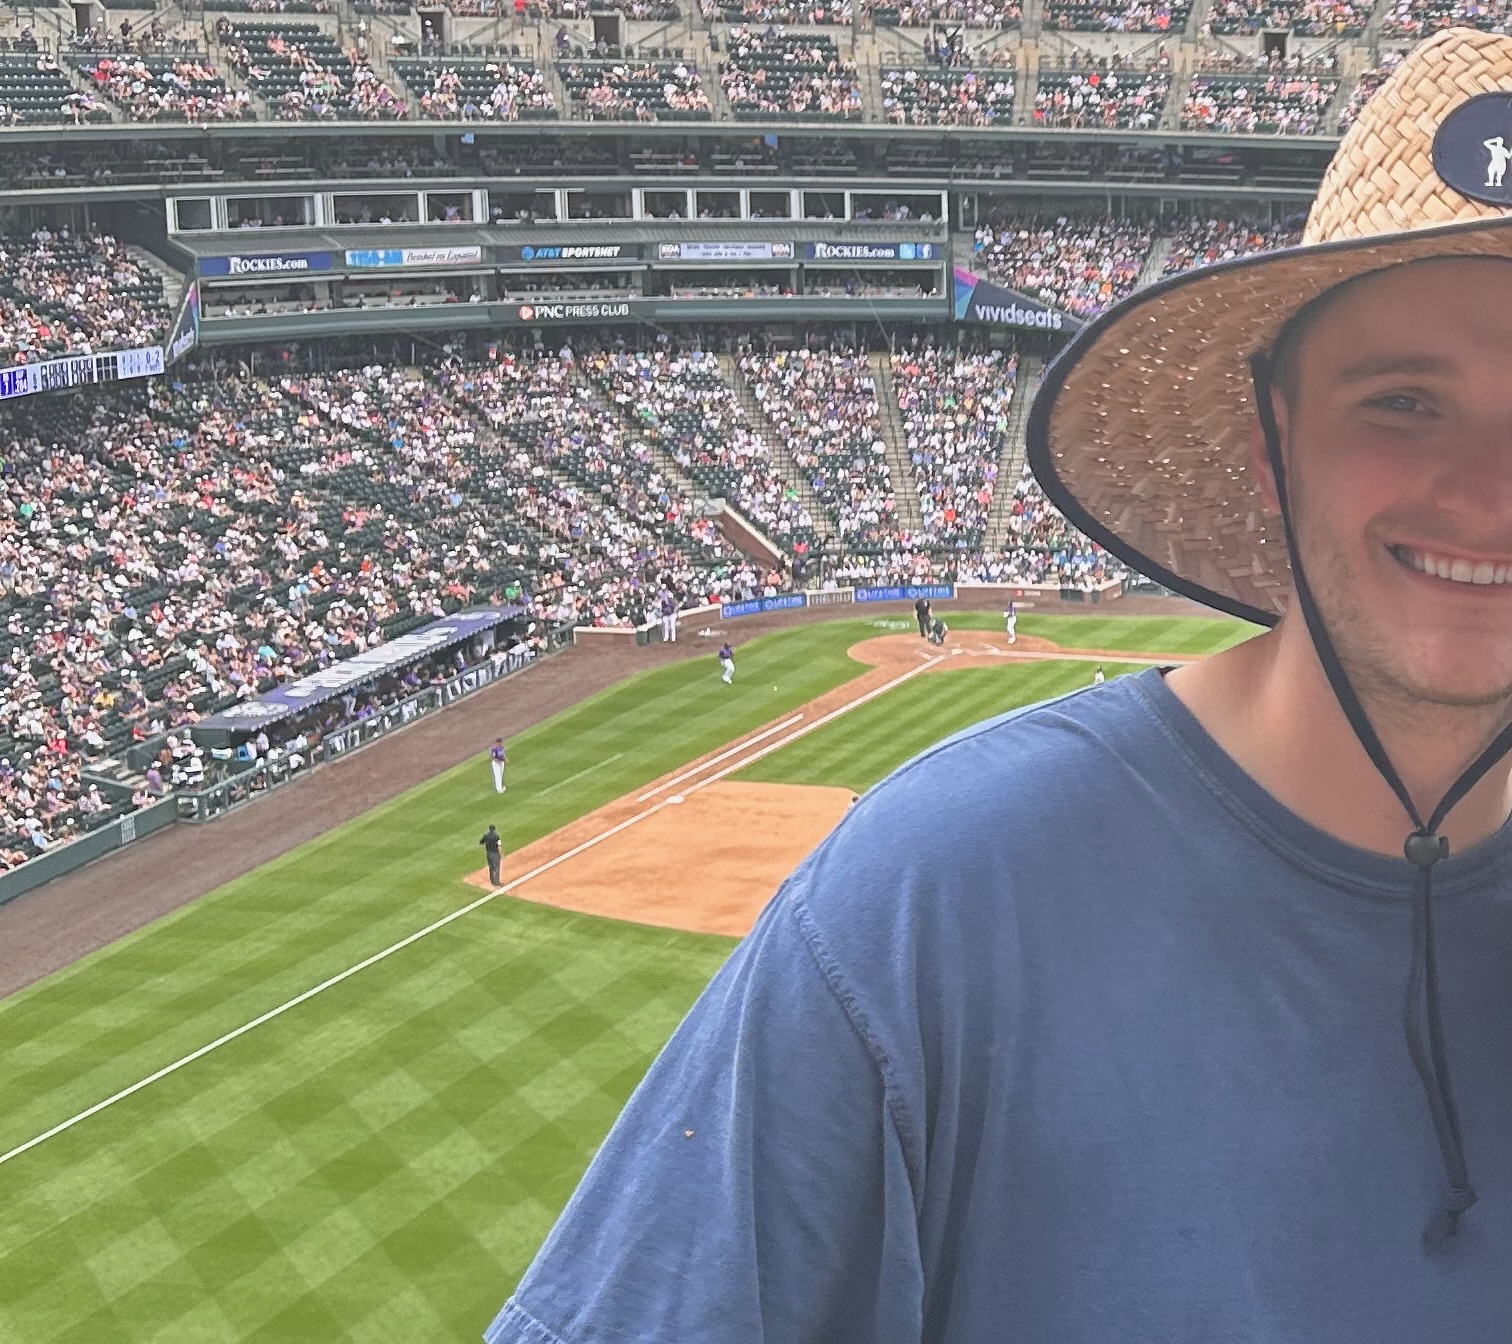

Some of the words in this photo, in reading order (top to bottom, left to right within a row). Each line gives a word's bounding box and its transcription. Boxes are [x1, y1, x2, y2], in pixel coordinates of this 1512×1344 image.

[535, 247, 561, 258] AT&T
[562, 246, 620, 258] SPORTSNET
[535, 305, 564, 319] PNC
[565, 305, 600, 318] PRESS
[601, 303, 629, 317] CLUB
[975, 302, 1062, 330] vividseats
